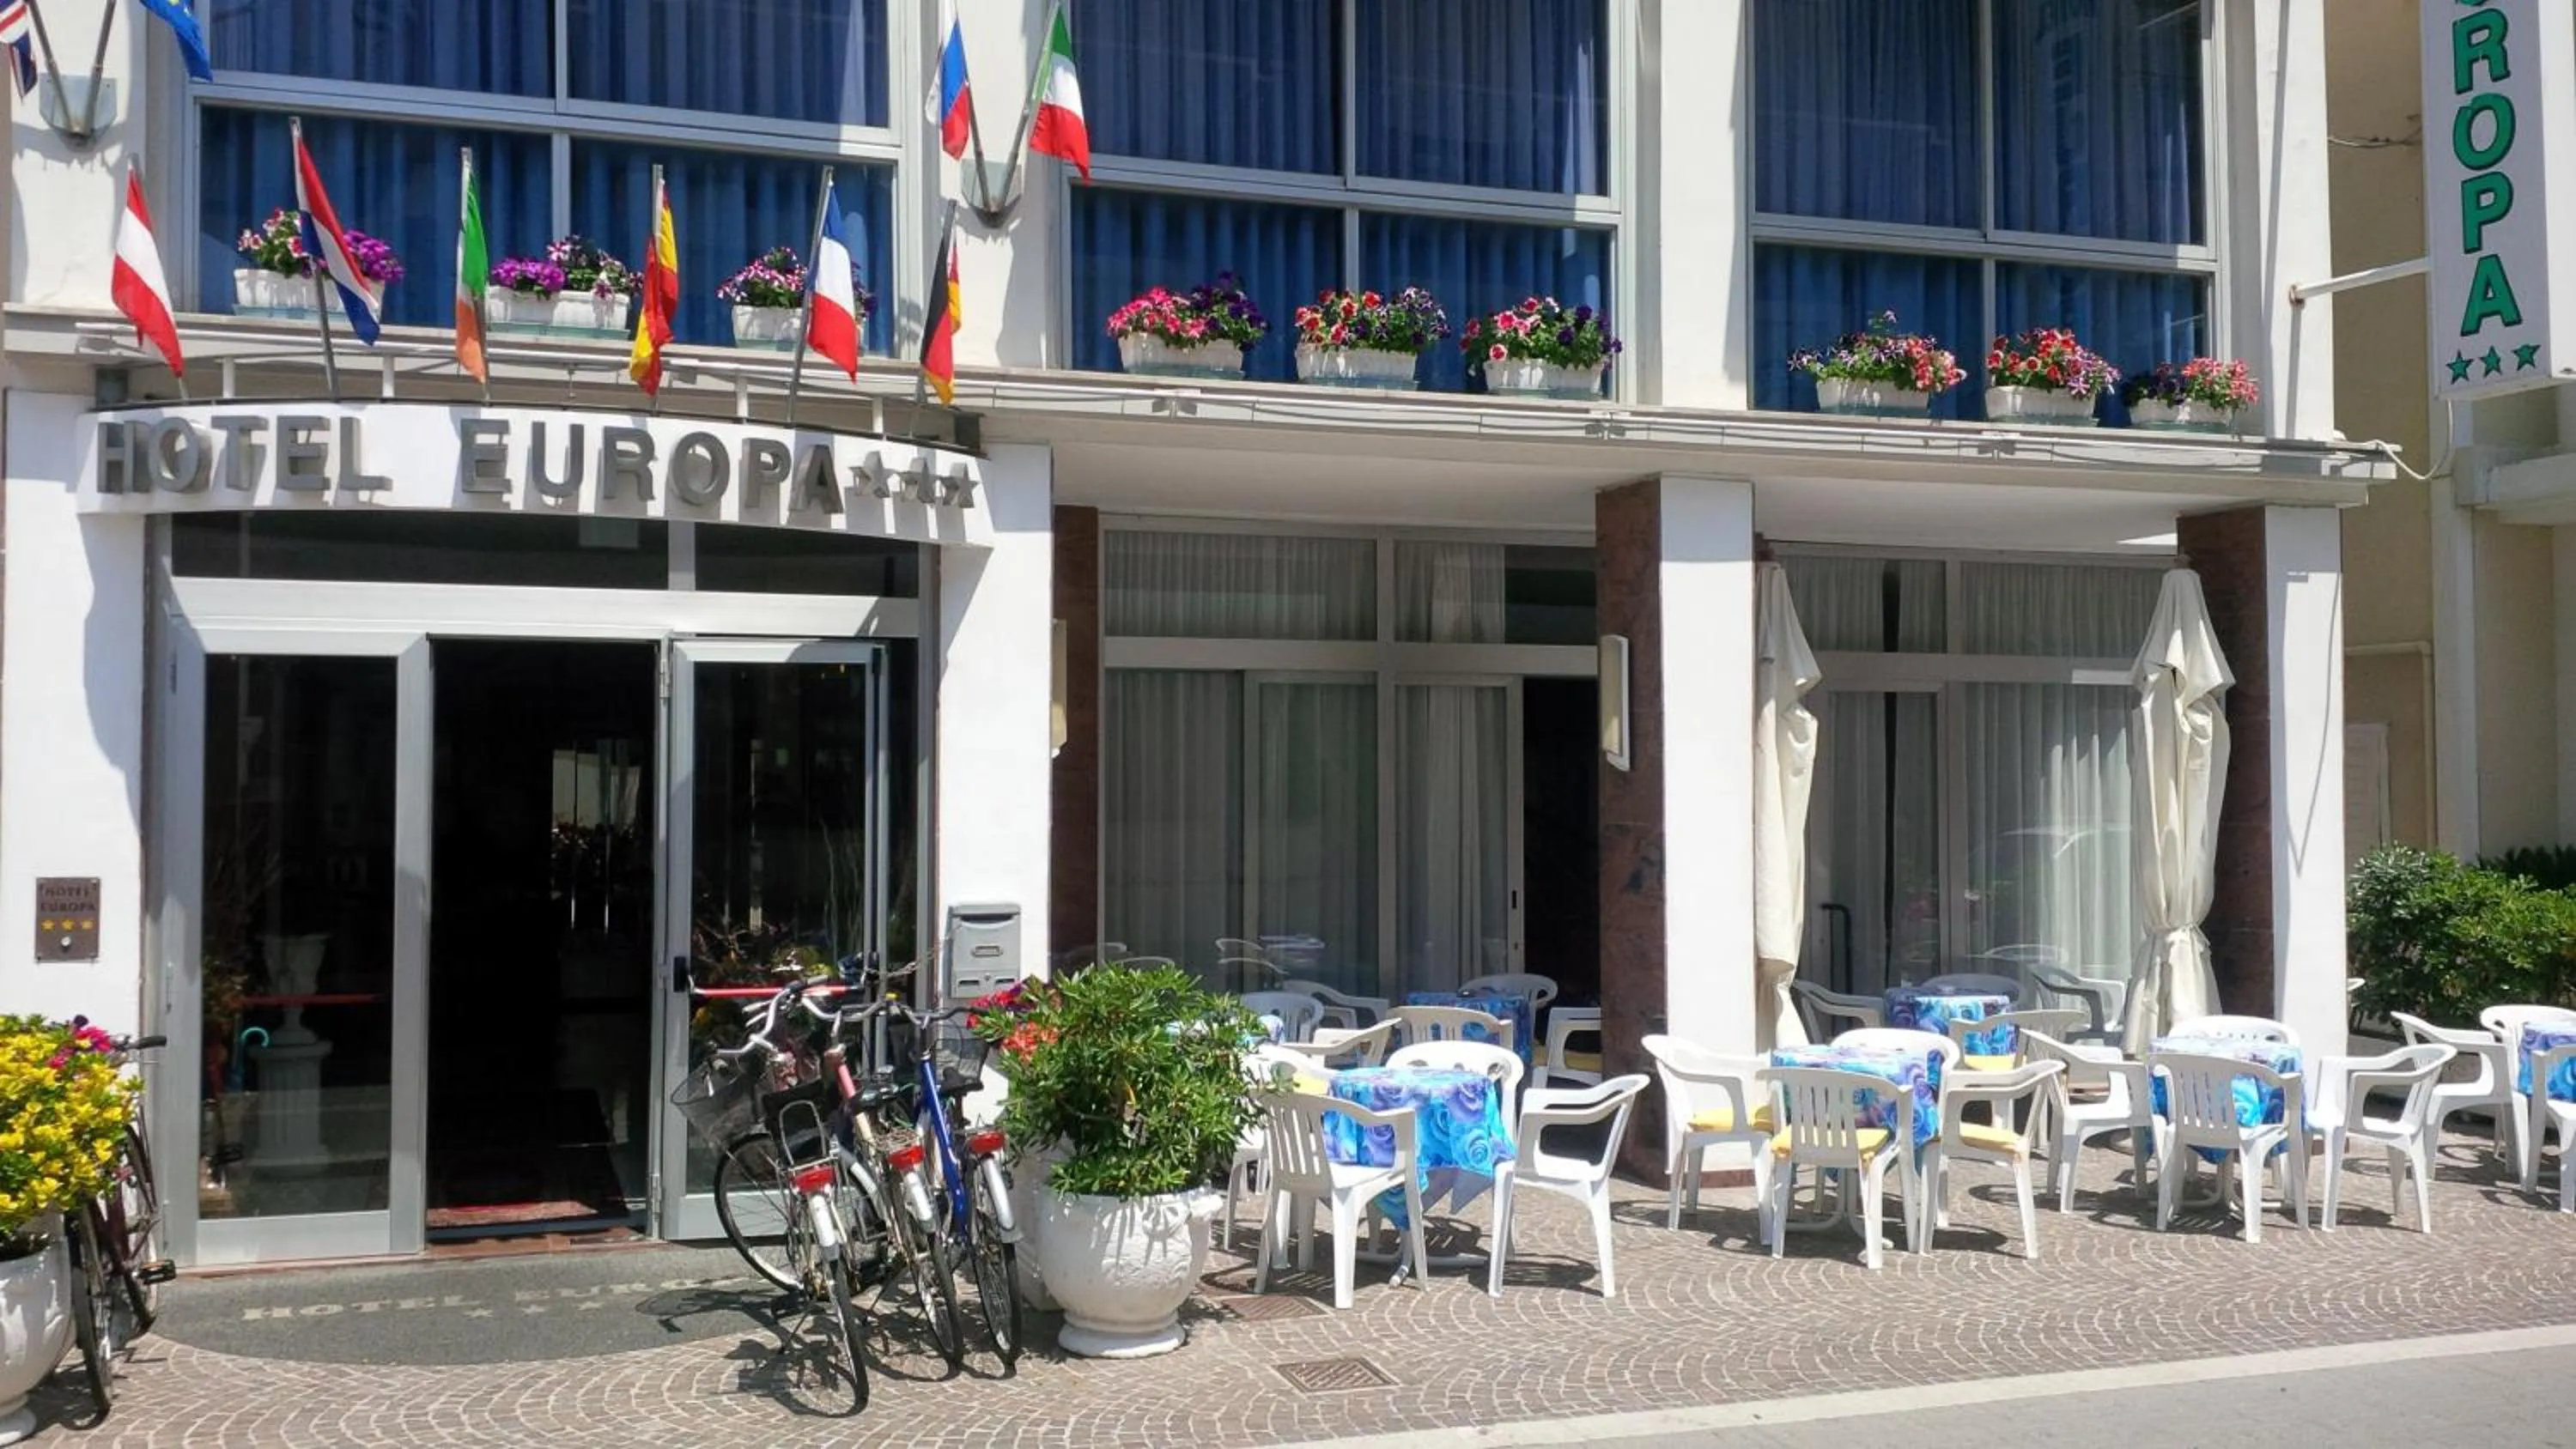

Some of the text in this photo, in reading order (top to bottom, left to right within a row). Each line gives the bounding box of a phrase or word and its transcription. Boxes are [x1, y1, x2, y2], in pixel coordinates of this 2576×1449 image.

[2451, 0, 2523, 336] ROPA
[96, 415, 845, 515] HOTEL EUROPA
[241, 1294, 481, 1320] HOTEL
